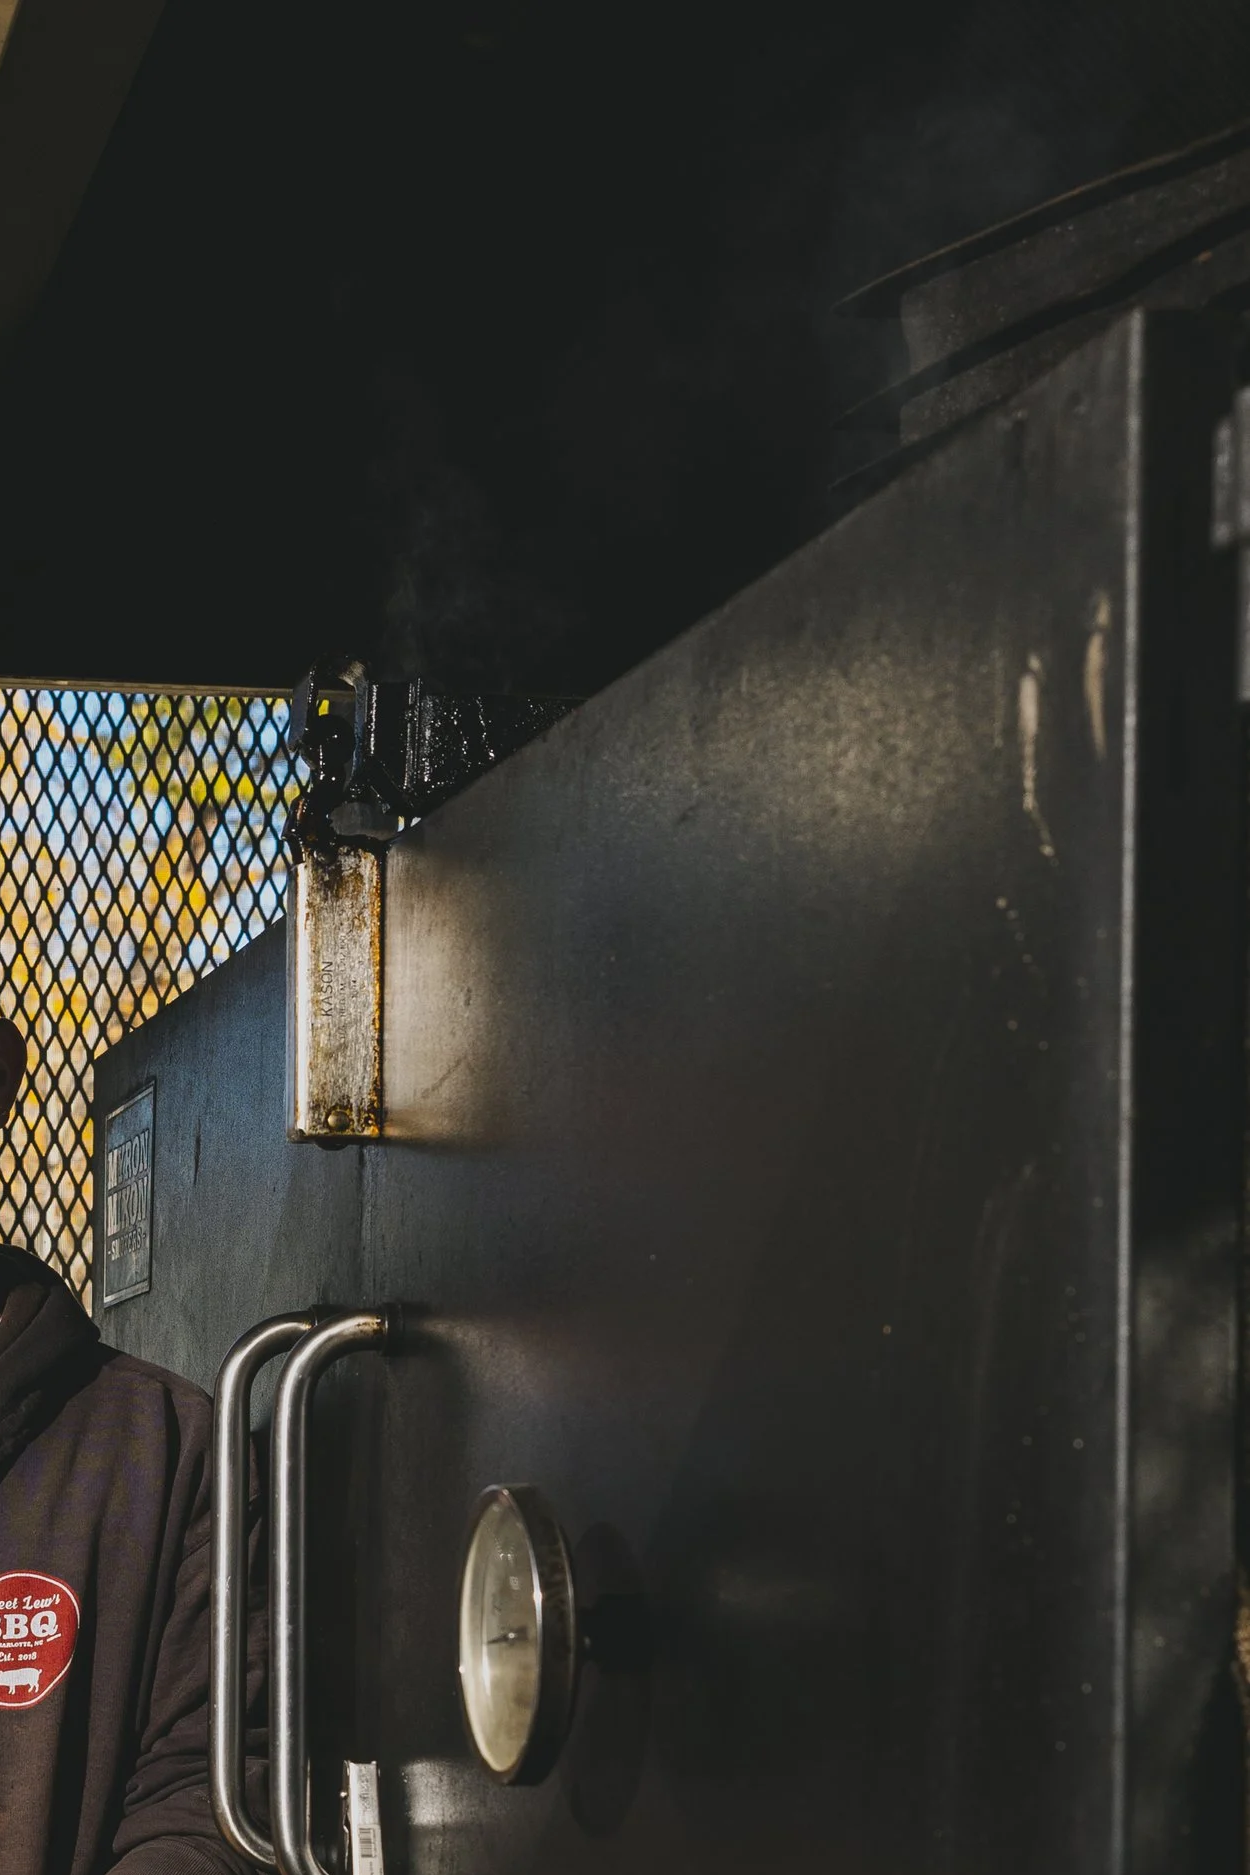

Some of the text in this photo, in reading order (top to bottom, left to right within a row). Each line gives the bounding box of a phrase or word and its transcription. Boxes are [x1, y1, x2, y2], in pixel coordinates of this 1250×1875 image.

[320, 961, 333, 1017] KASON
[107, 1129, 149, 1190] MYRON
[107, 1174, 149, 1237] MIXON
[22, 1593, 61, 1610] Lew's
[17, 1651, 37, 1661] 2018
[33, 1639, 44, 1647] NC
